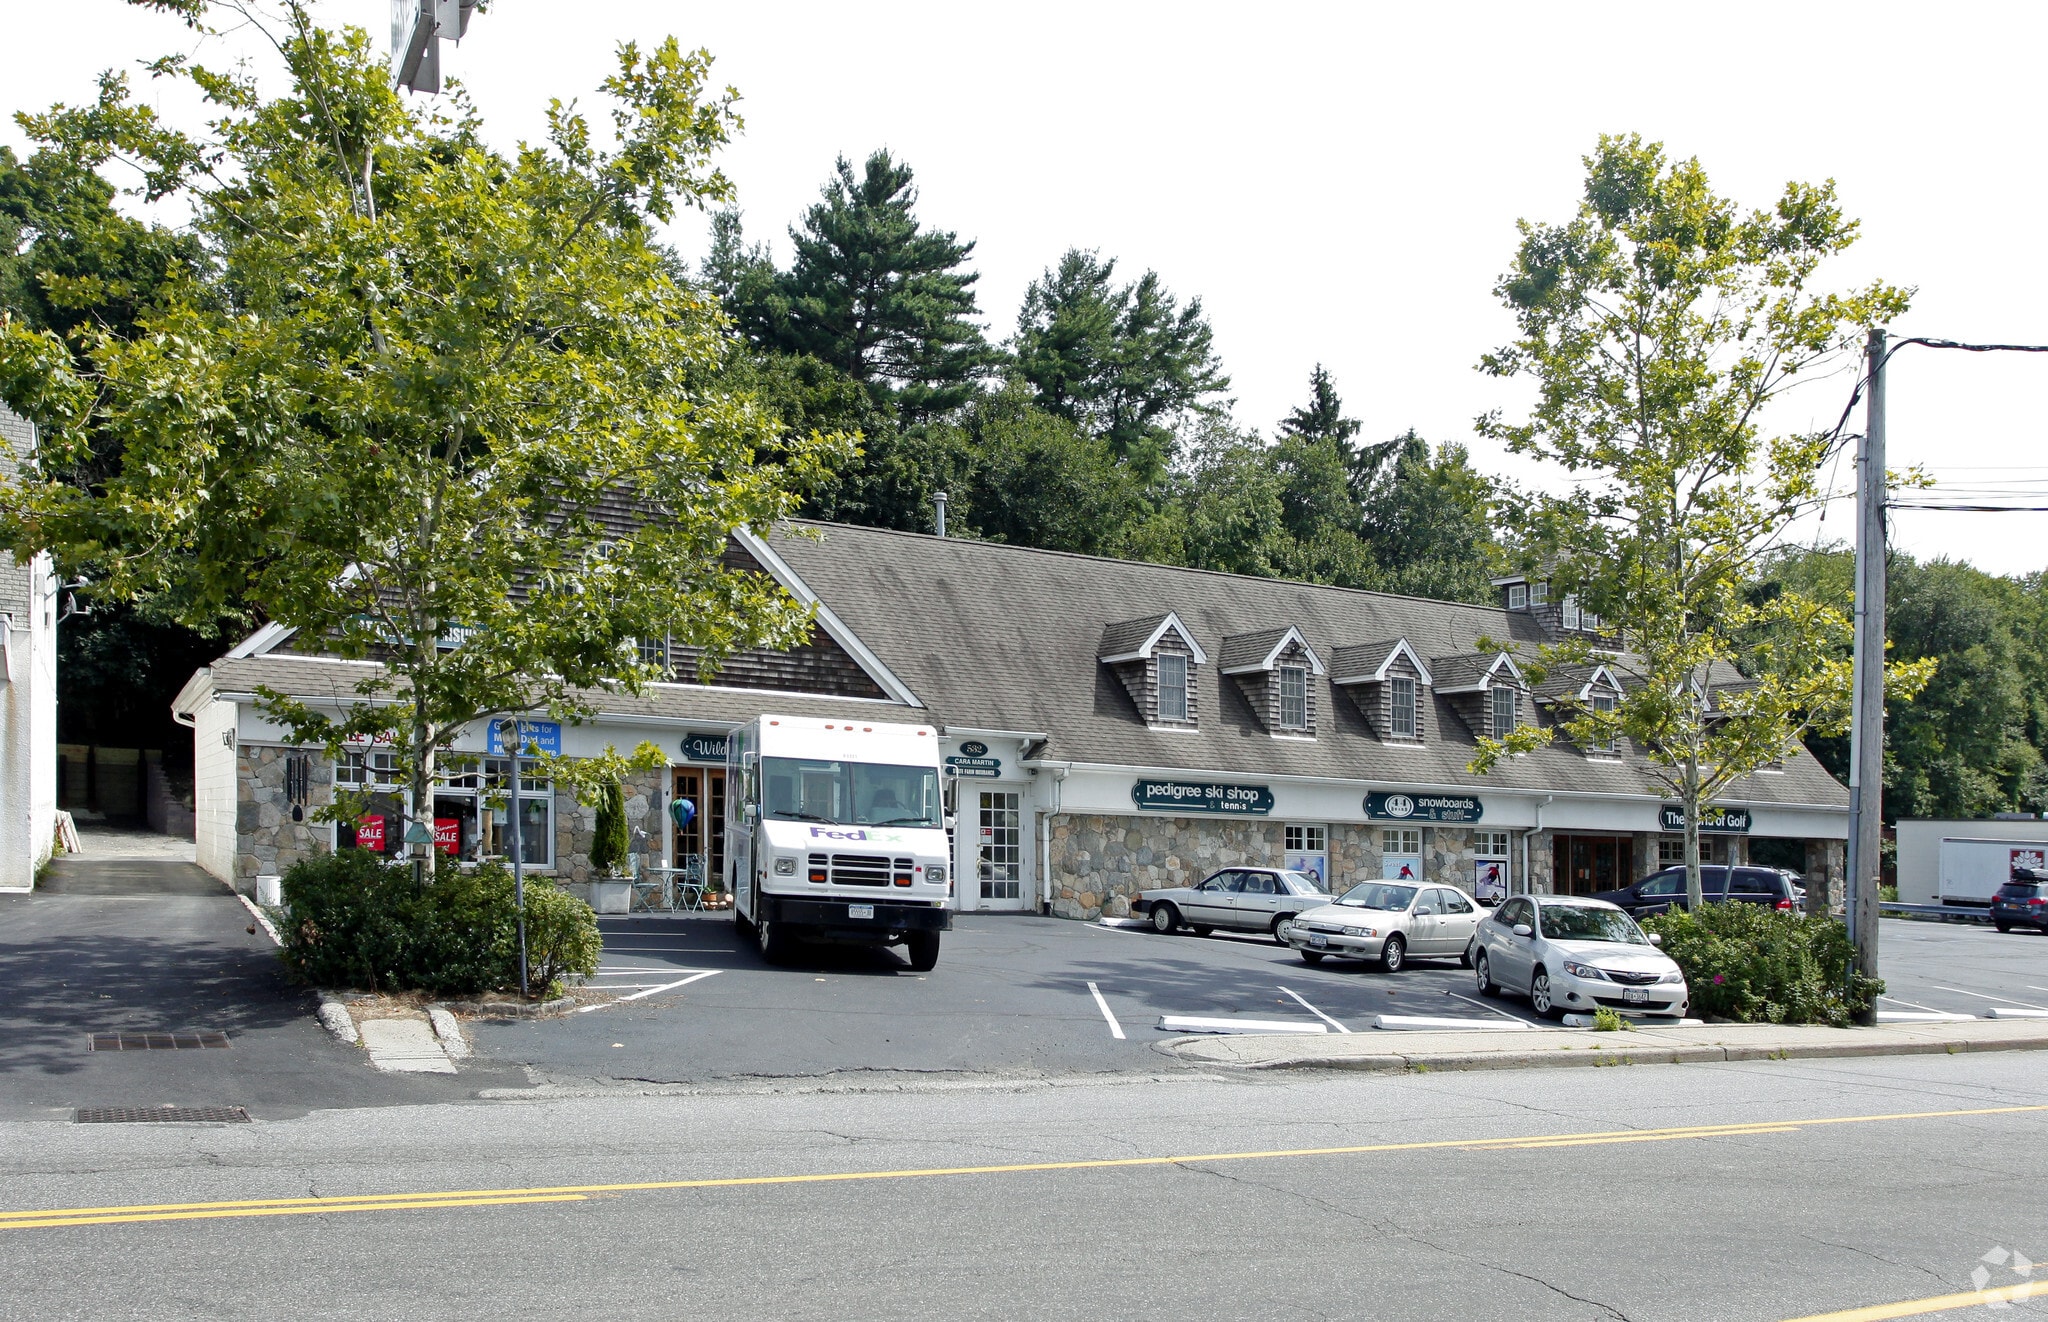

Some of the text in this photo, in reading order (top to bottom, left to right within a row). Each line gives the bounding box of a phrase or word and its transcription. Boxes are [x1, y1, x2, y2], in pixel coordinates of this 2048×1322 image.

[541, 724, 553, 734] for
[520, 735, 555, 745] Dad and
[966, 744, 983, 754] 532
[954, 757, 971, 765] CARA
[1147, 783, 1259, 804] pedigree ski shop
[1220, 801, 1247, 810] tennis
[1418, 797, 1474, 809] snowboards
[1428, 808, 1465, 820] & stuff
[1666, 811, 1685, 825] The
[1715, 816, 1725, 827] of
[1727, 814, 1747, 828] Golf
[358, 828, 382, 839] SALE
[434, 832, 457, 842] SALE
[809, 826, 903, 842] FedEx
